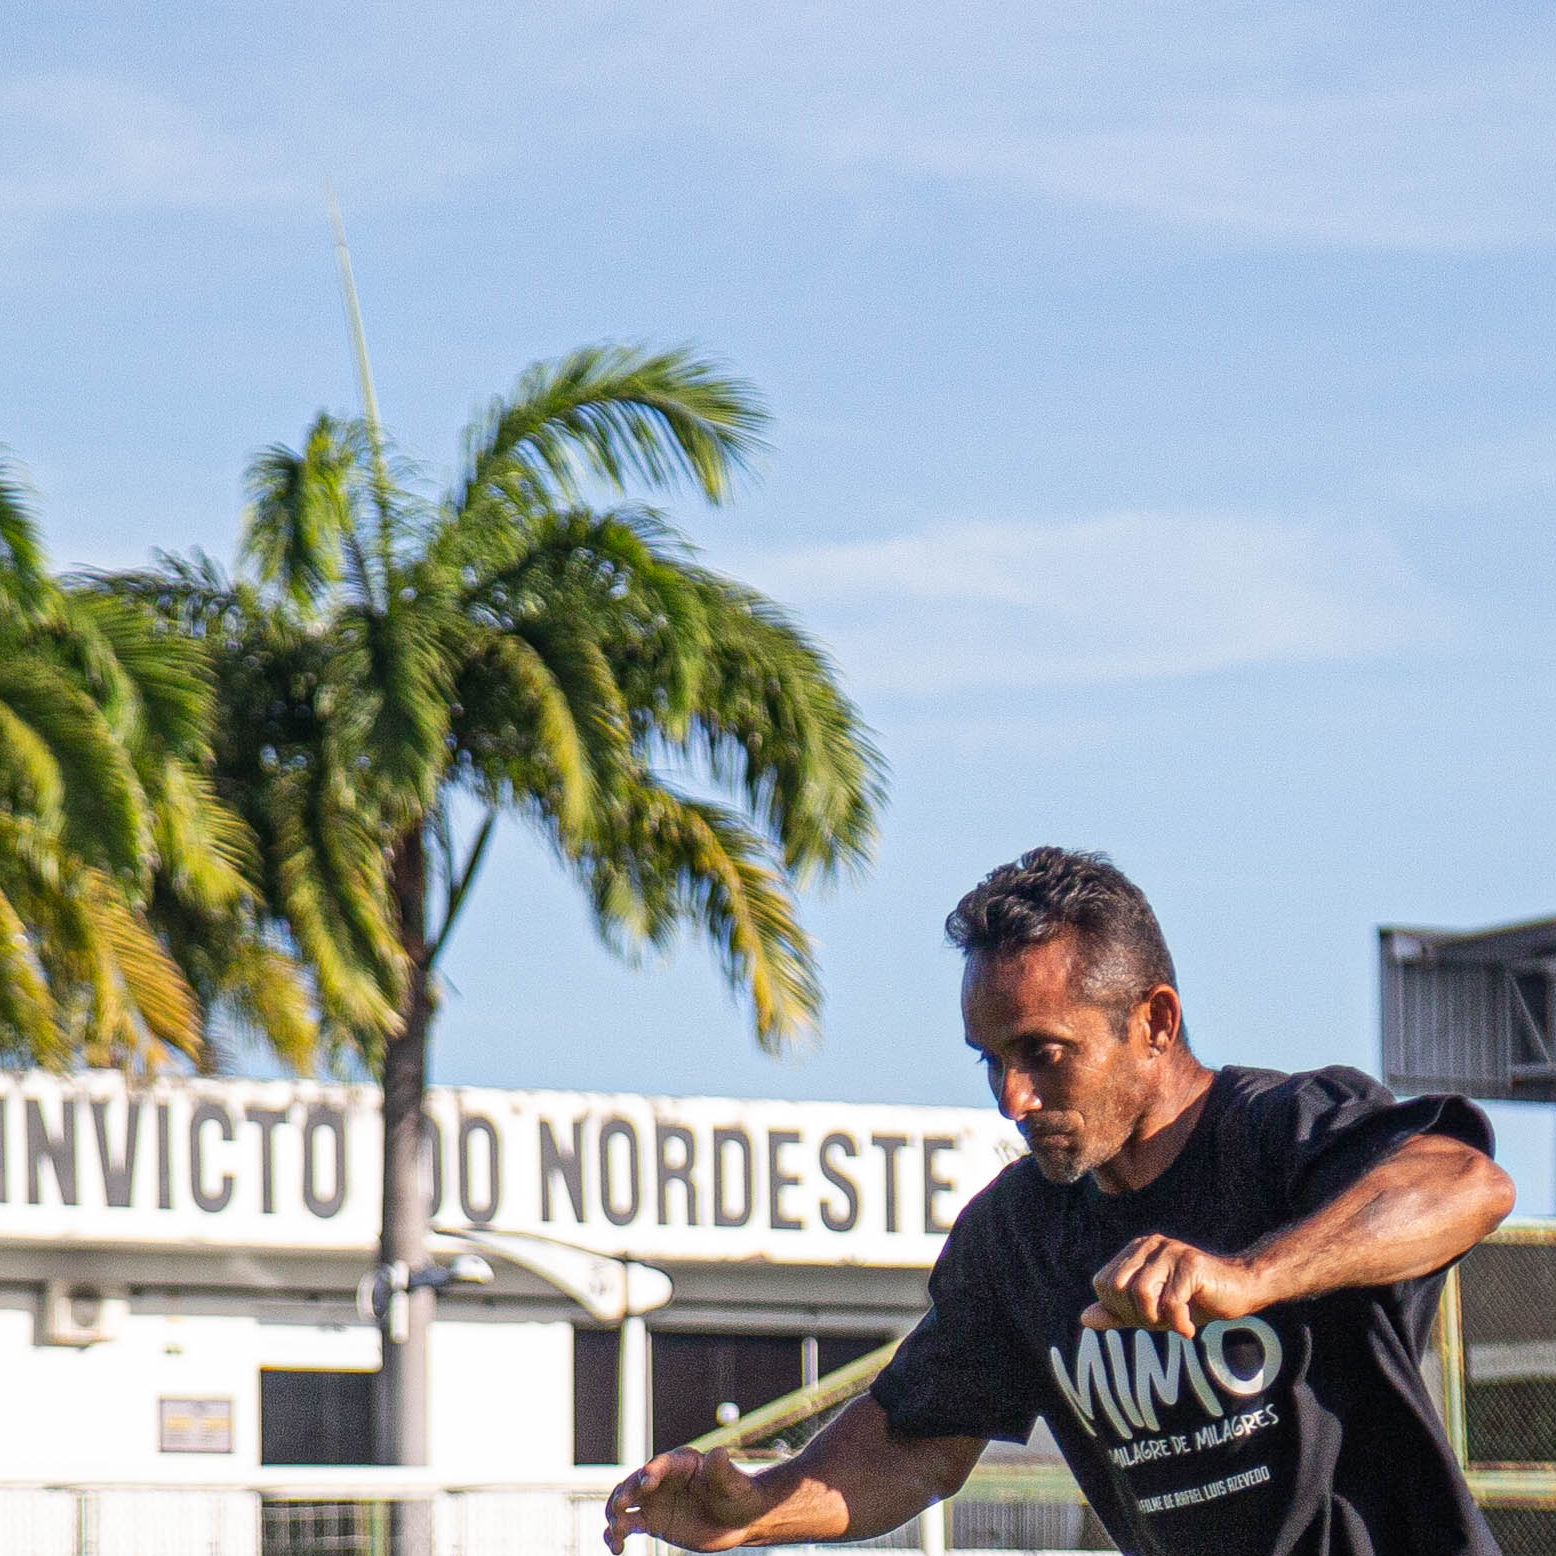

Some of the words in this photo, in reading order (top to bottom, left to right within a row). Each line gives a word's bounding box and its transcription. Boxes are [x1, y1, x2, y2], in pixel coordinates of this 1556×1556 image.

[540, 1115, 957, 1234] NORDESTE
[1050, 1315, 1283, 1440] MIMO
[1109, 1438, 1172, 1468] MILAGRE
[1169, 1435, 1192, 1454] DE
[1195, 1403, 1279, 1450] MILAGRES
[1203, 1480, 1227, 1500] LUIS
